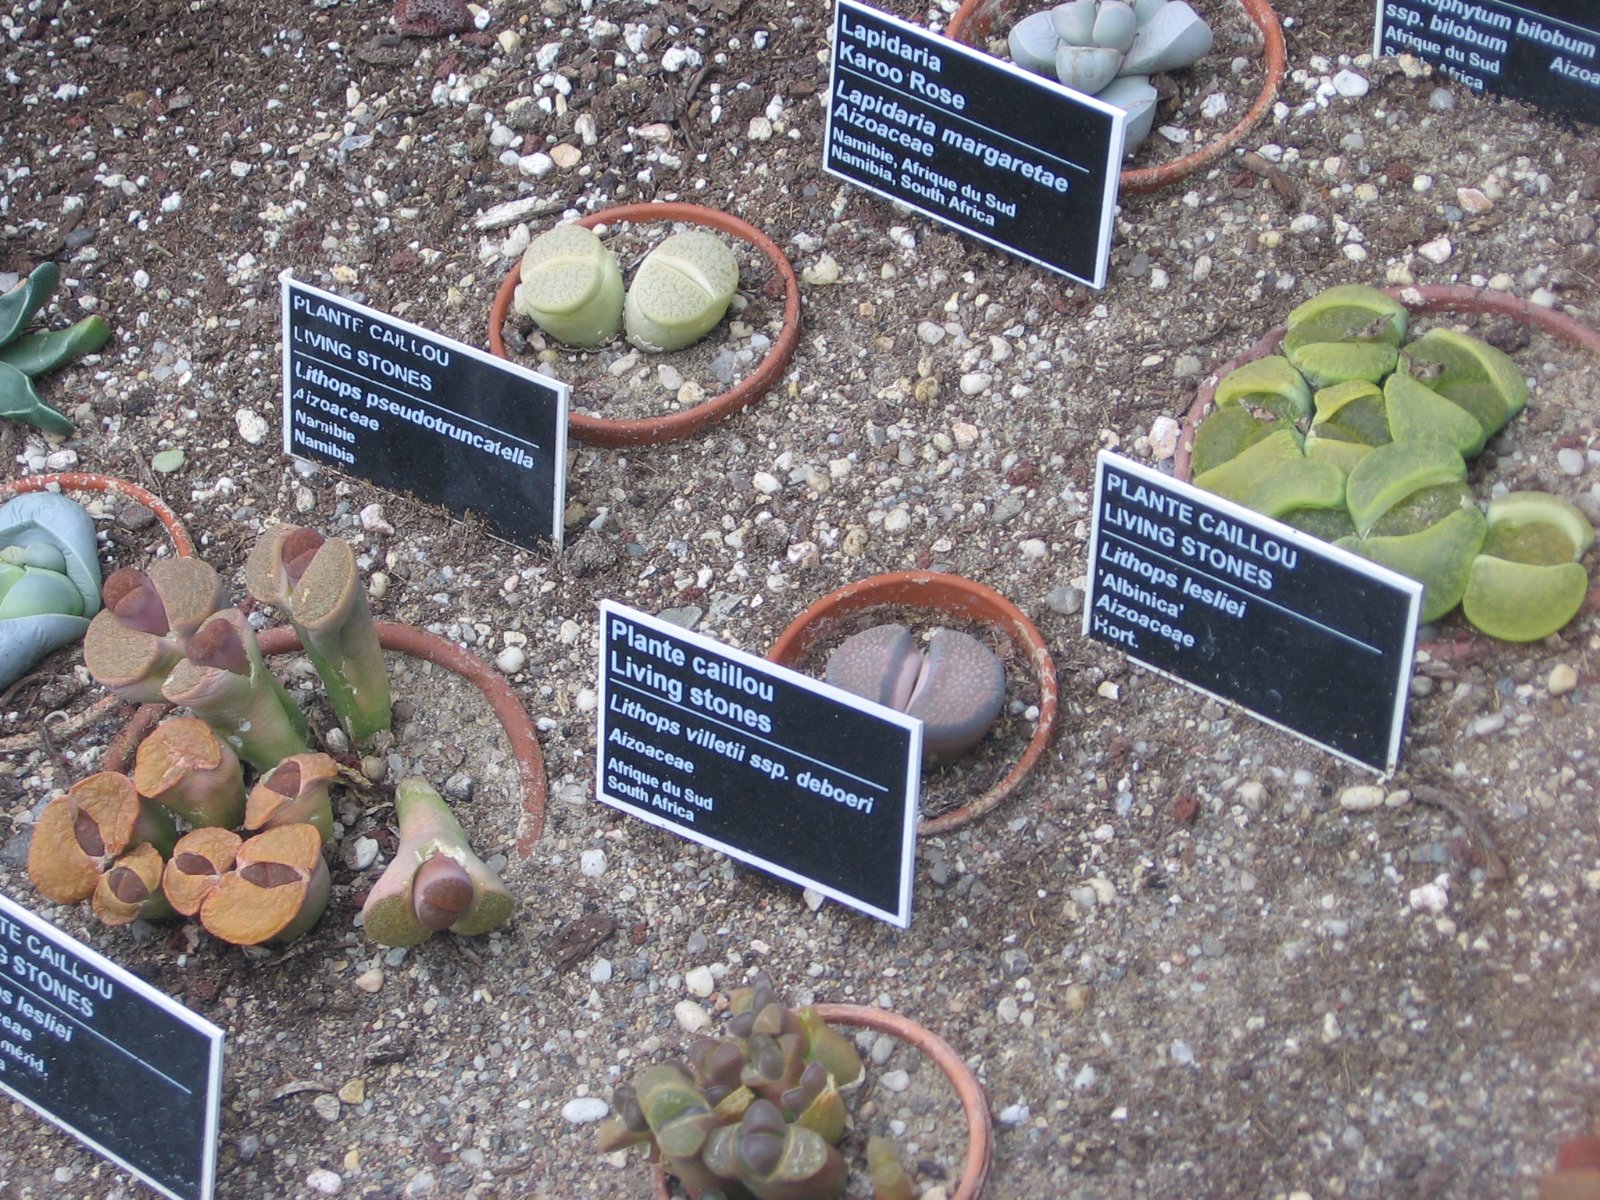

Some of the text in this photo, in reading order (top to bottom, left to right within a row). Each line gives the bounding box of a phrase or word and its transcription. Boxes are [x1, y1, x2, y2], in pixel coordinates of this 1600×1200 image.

[842, 14, 941, 72] Lapidaria
[1385, 26, 1441, 54] Afrique
[1445, 46, 1464, 60] du
[1469, 52, 1499, 74] Sud
[1386, 4, 1508, 53] ssp. bilobum
[1516, 18, 1596, 58] bilobum
[840, 42, 965, 110] Karoo Rose
[834, 103, 934, 157] Aizoaceae
[836, 79, 1068, 192] Lapidaria margaretae
[832, 144, 995, 226] Namibia, South Africa
[833, 126, 1016, 217] Namibie, Afrique du Sud
[294, 296, 449, 366] PLANTE CAILLOU
[294, 326, 432, 391] LIVING STONES
[294, 388, 379, 430] Aizoaceae
[296, 362, 534, 468] Lithops pseudotruncatella
[296, 410, 355, 444] Namibie
[294, 429, 355, 464] Namibia
[1104, 503, 1273, 589] LIVING STONES
[1108, 473, 1298, 568] PLANTE CAILLOU
[1099, 569, 1184, 618] 'Albinica'
[1101, 542, 1246, 618] Lithops lesliei
[1096, 594, 1195, 647] Aizoaceae
[612, 620, 774, 702] Plante caillou
[612, 651, 772, 733] Living stones
[609, 728, 694, 773] Aizoaceae
[610, 694, 874, 814] Lithops villetii ssp. deboeri
[608, 758, 714, 811] Afrique du Sud
[608, 776, 694, 822] South Africa
[13, 956, 94, 1017] STONES
[26, 936, 113, 999] CAILLOU
[16, 996, 73, 1042] lesliei
